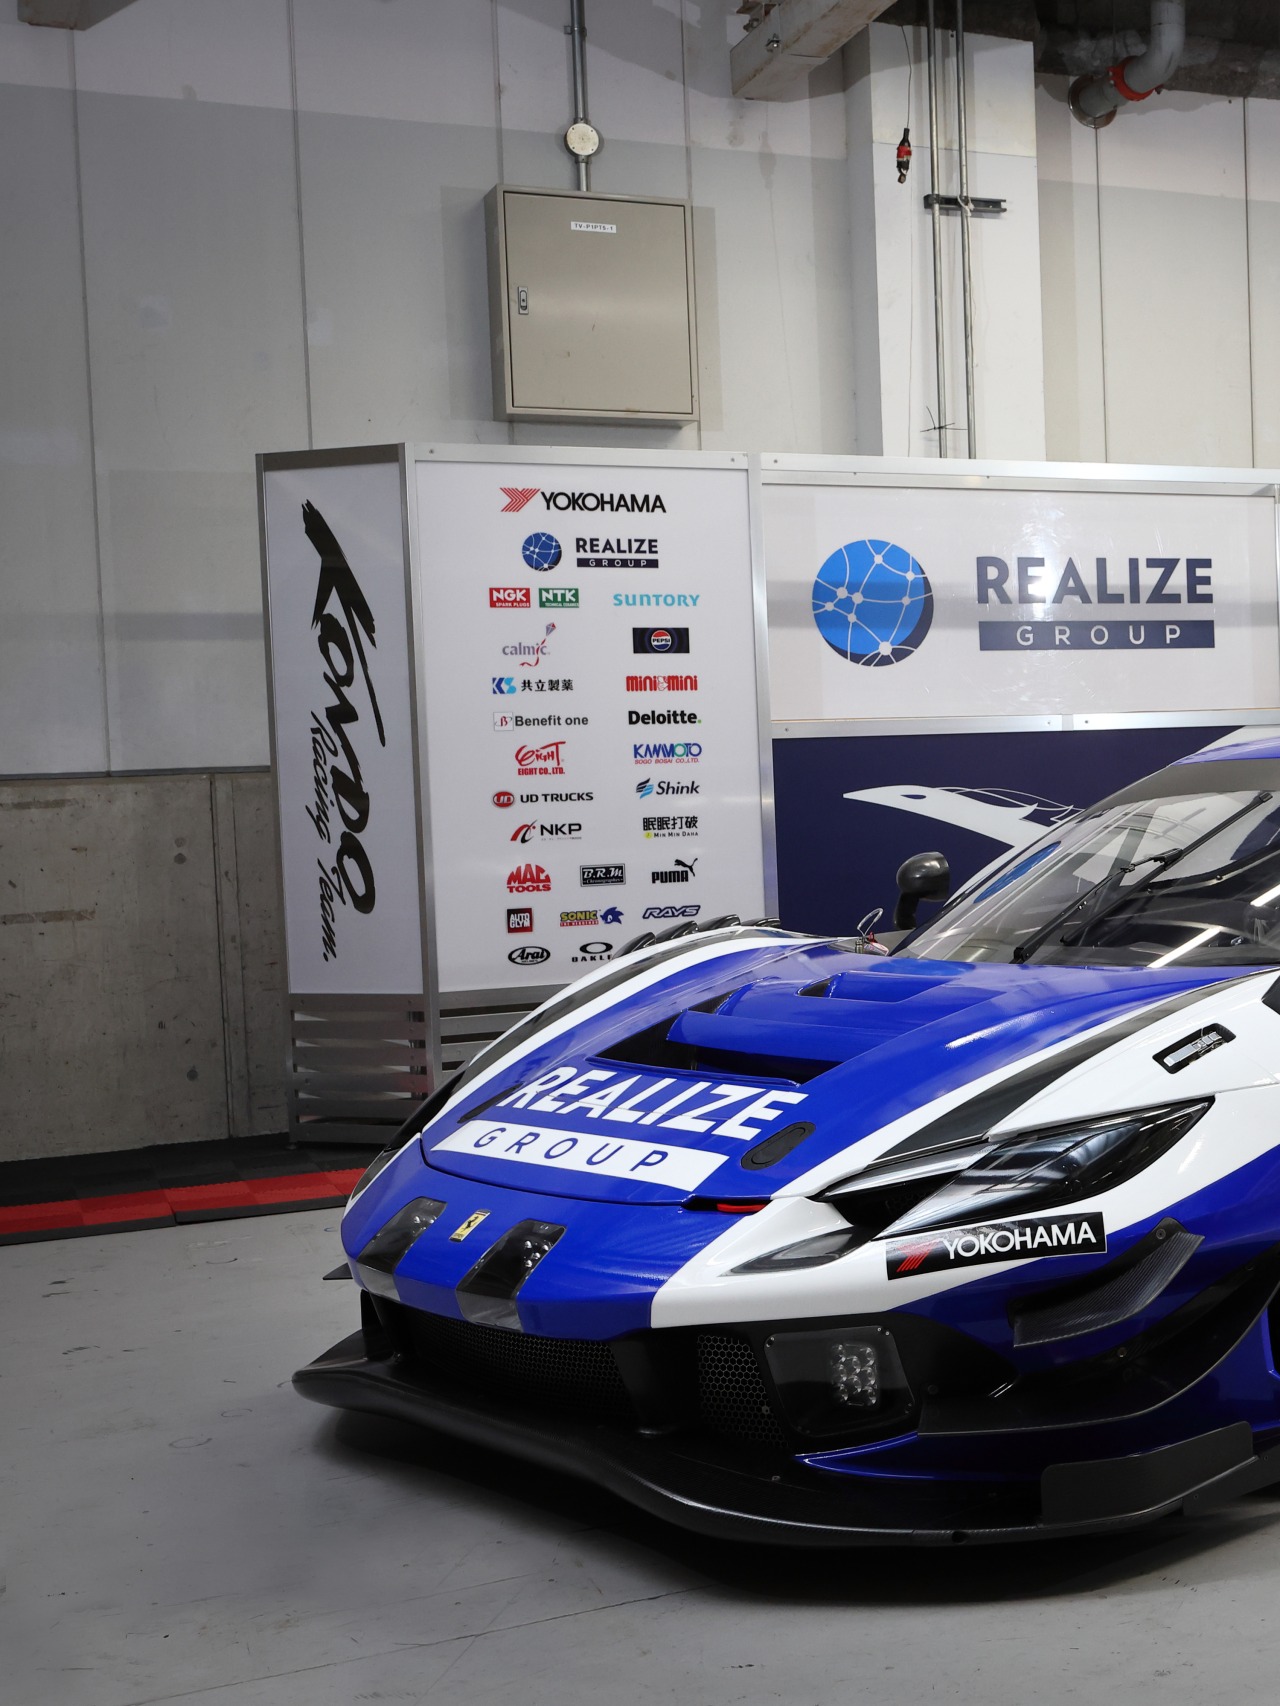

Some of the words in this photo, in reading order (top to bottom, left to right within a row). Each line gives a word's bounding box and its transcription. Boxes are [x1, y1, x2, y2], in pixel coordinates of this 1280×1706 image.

[540, 491, 666, 513] YOKOHAMA
[575, 537, 659, 554] REALIZE
[589, 558, 647, 567] GROUP
[976, 556, 1214, 605] REALIZE
[492, 589, 527, 602] NGK
[542, 589, 576, 602] NTK
[1016, 625, 1181, 647] GROUP
[521, 679, 574, 692] 共立製薬
[514, 715, 562, 727] Benefit
[564, 716, 589, 726] one
[517, 767, 538, 776] EIGHT
[551, 766, 566, 775] LTD.
[655, 780, 700, 795] Shink
[520, 794, 539, 803] UD
[541, 792, 594, 802] TRUCKS
[540, 822, 582, 836] NKP
[642, 815, 699, 831] 眠眠打破
[507, 863, 551, 885] MAC
[651, 870, 689, 884] PUMA
[507, 884, 552, 894] TOOLS
[509, 913, 530, 921] AUTO
[560, 910, 599, 922] SONIC
[642, 904, 701, 919] RAYS
[509, 920, 531, 929] GLYM
[497, 1066, 809, 1141] REALIZE
[473, 1127, 668, 1172] GROUP
[942, 1221, 1097, 1260] YOKOHAMA
